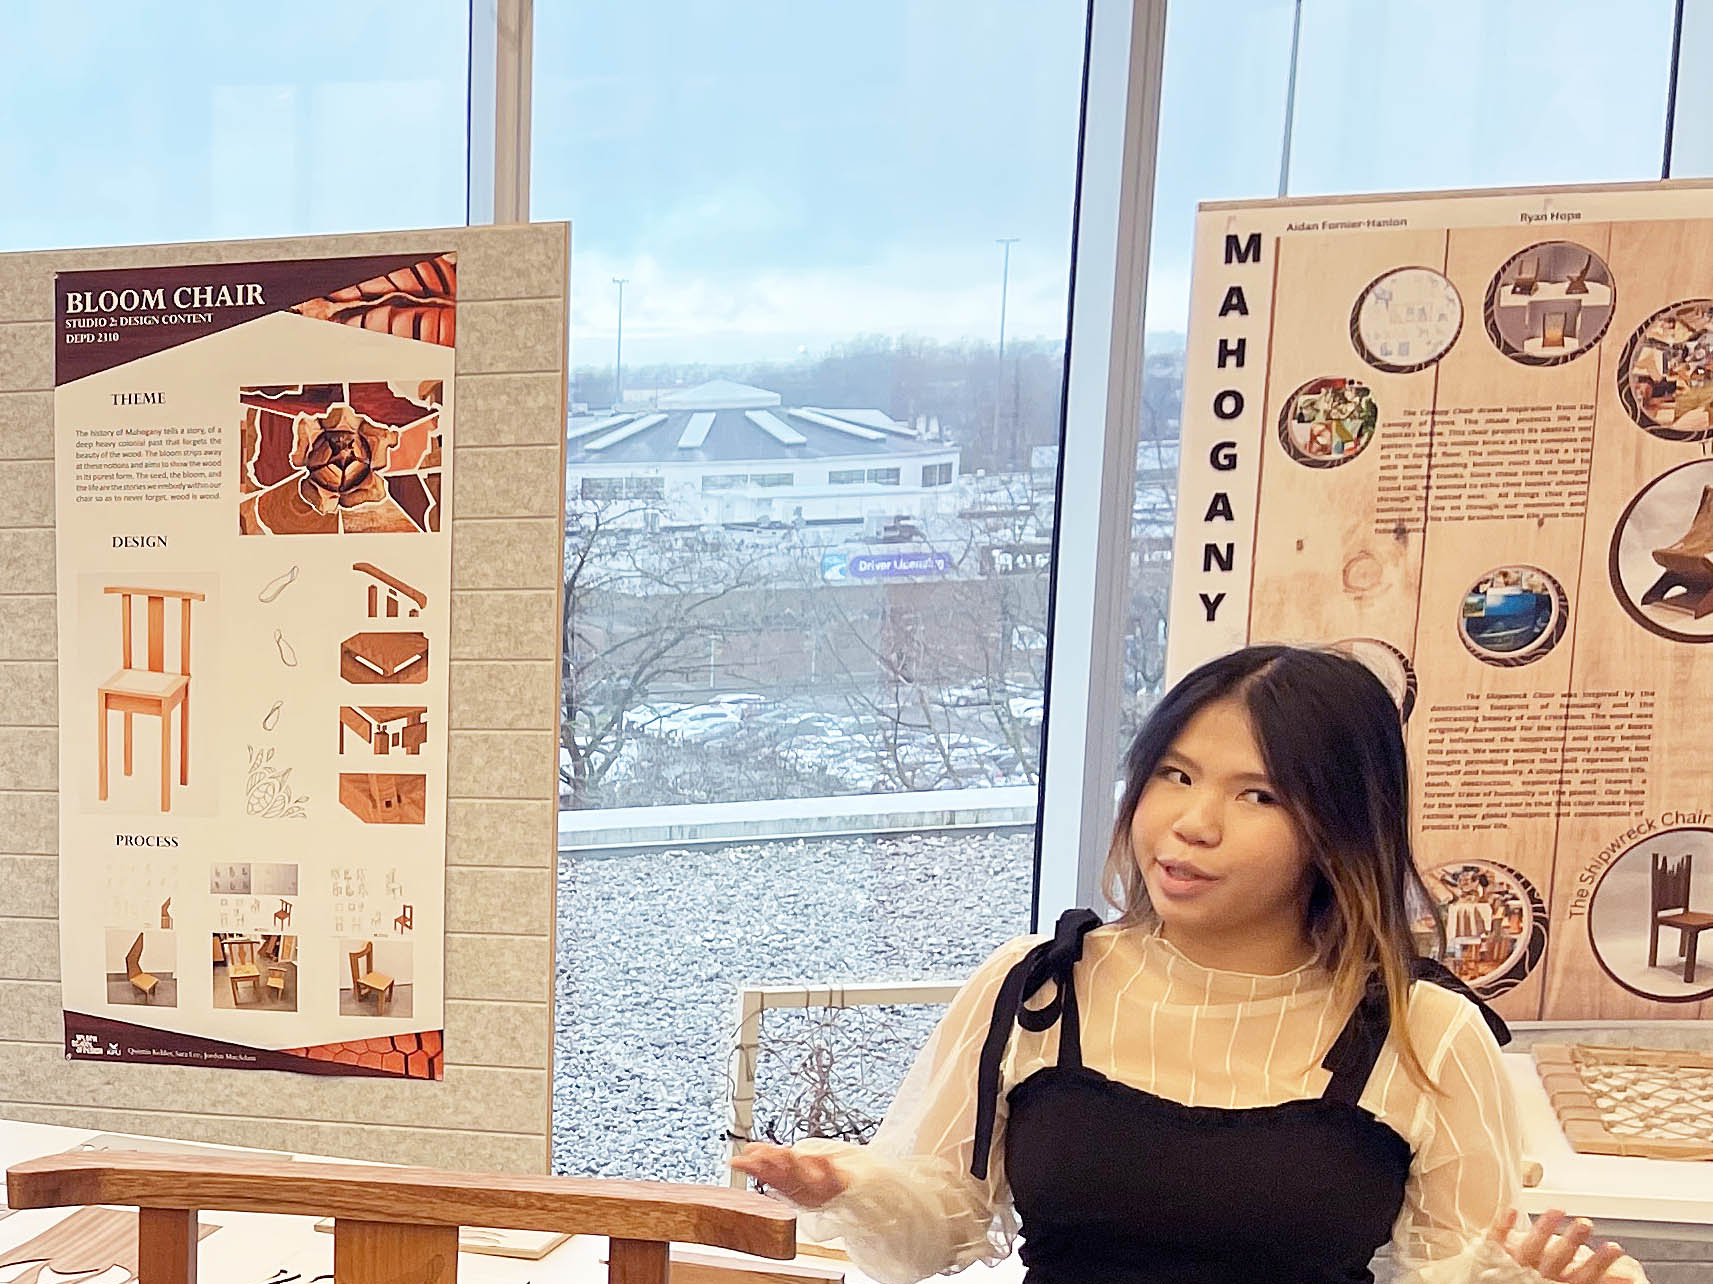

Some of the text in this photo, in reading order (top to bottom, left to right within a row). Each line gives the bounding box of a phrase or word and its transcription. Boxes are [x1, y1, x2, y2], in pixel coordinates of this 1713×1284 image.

[1519, 211, 1582, 223] Ryan Hope
[1286, 221, 1319, 232] Aidan
[66, 284, 265, 313] BLOOM CHAIR
[65, 316, 107, 328] STUDIO
[120, 316, 160, 326] DESIGN
[162, 313, 213, 324] CONTENT
[66, 333, 95, 344] DEPD
[111, 392, 166, 406] THEME
[90, 429, 113, 437] history
[1198, 232, 1261, 622] MAHOGANY
[76, 441, 93, 449] deep
[112, 535, 168, 549] DESIGN
[859, 560, 890, 571] Driver
[116, 834, 179, 848] PROCESS
[1569, 809, 1712, 919] The Shipwreck Chair
